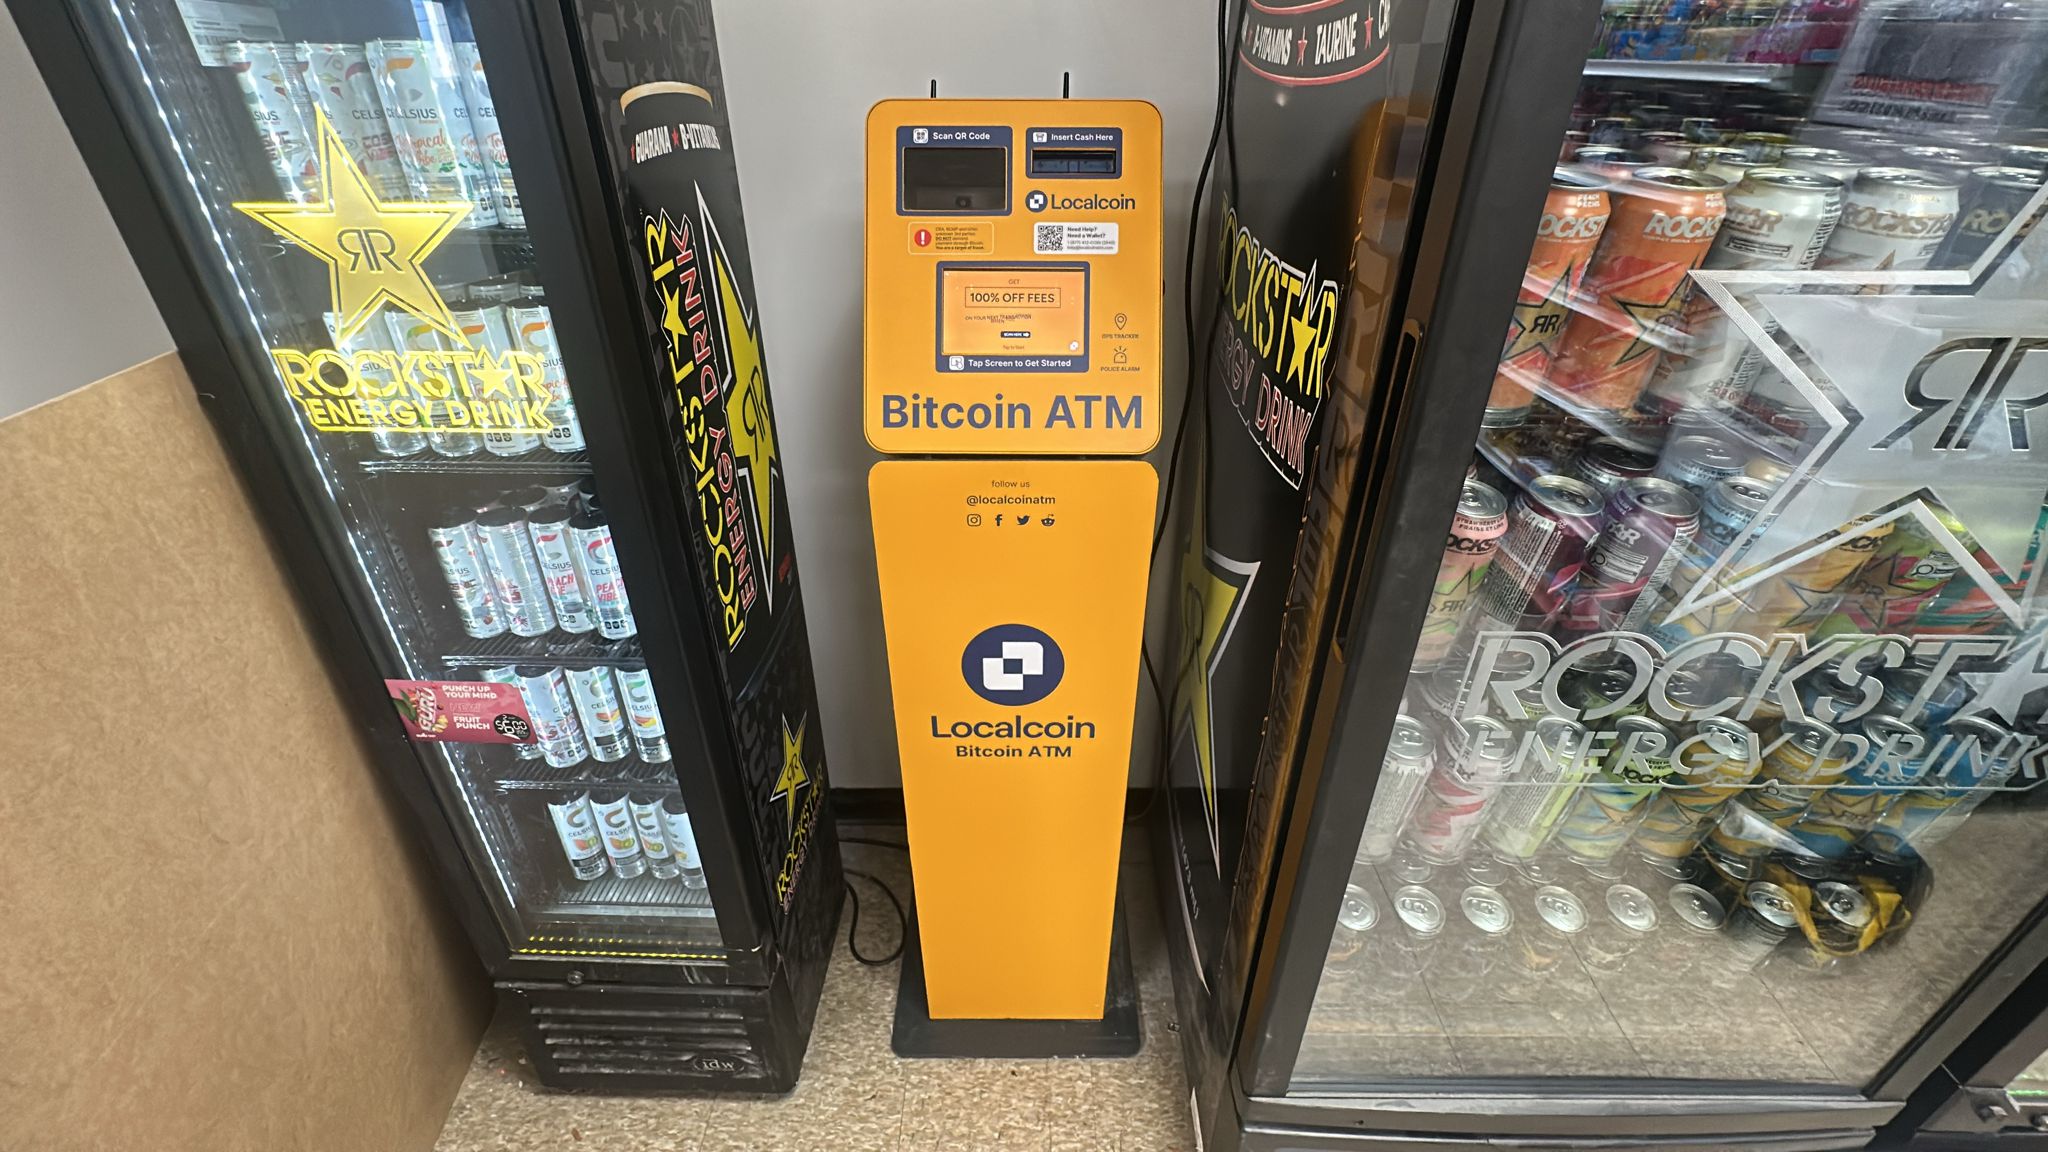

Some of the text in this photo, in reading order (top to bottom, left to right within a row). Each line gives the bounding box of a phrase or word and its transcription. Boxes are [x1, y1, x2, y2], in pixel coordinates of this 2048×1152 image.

[1314, 13, 1358, 65] TAURINE
[635, 125, 672, 164] GUARANA
[932, 131, 991, 141] Scan QR Code
[1051, 133, 1114, 142] Insert Cash Here
[1051, 193, 1136, 210] Localcoin
[969, 292, 1055, 303] 100% OFF FEES
[968, 359, 1072, 368] Tap Screen to Get Started
[309, 399, 549, 428] ENERGY DRINK
[670, 222, 756, 611] ENERGY DRINK
[883, 393, 1143, 430] Bitcoin ATM
[1254, 372, 1312, 474] DRINK
[992, 480, 1018, 488] follow
[966, 495, 1056, 506] @localcoinatm
[445, 691, 472, 699] YOUR
[419, 687, 437, 731] GURU
[456, 722, 490, 730] PUNCH
[930, 715, 1096, 739] Localcoin
[956, 745, 1072, 758] Bitcoin ATM
[1471, 730, 1795, 776] ENERGY
